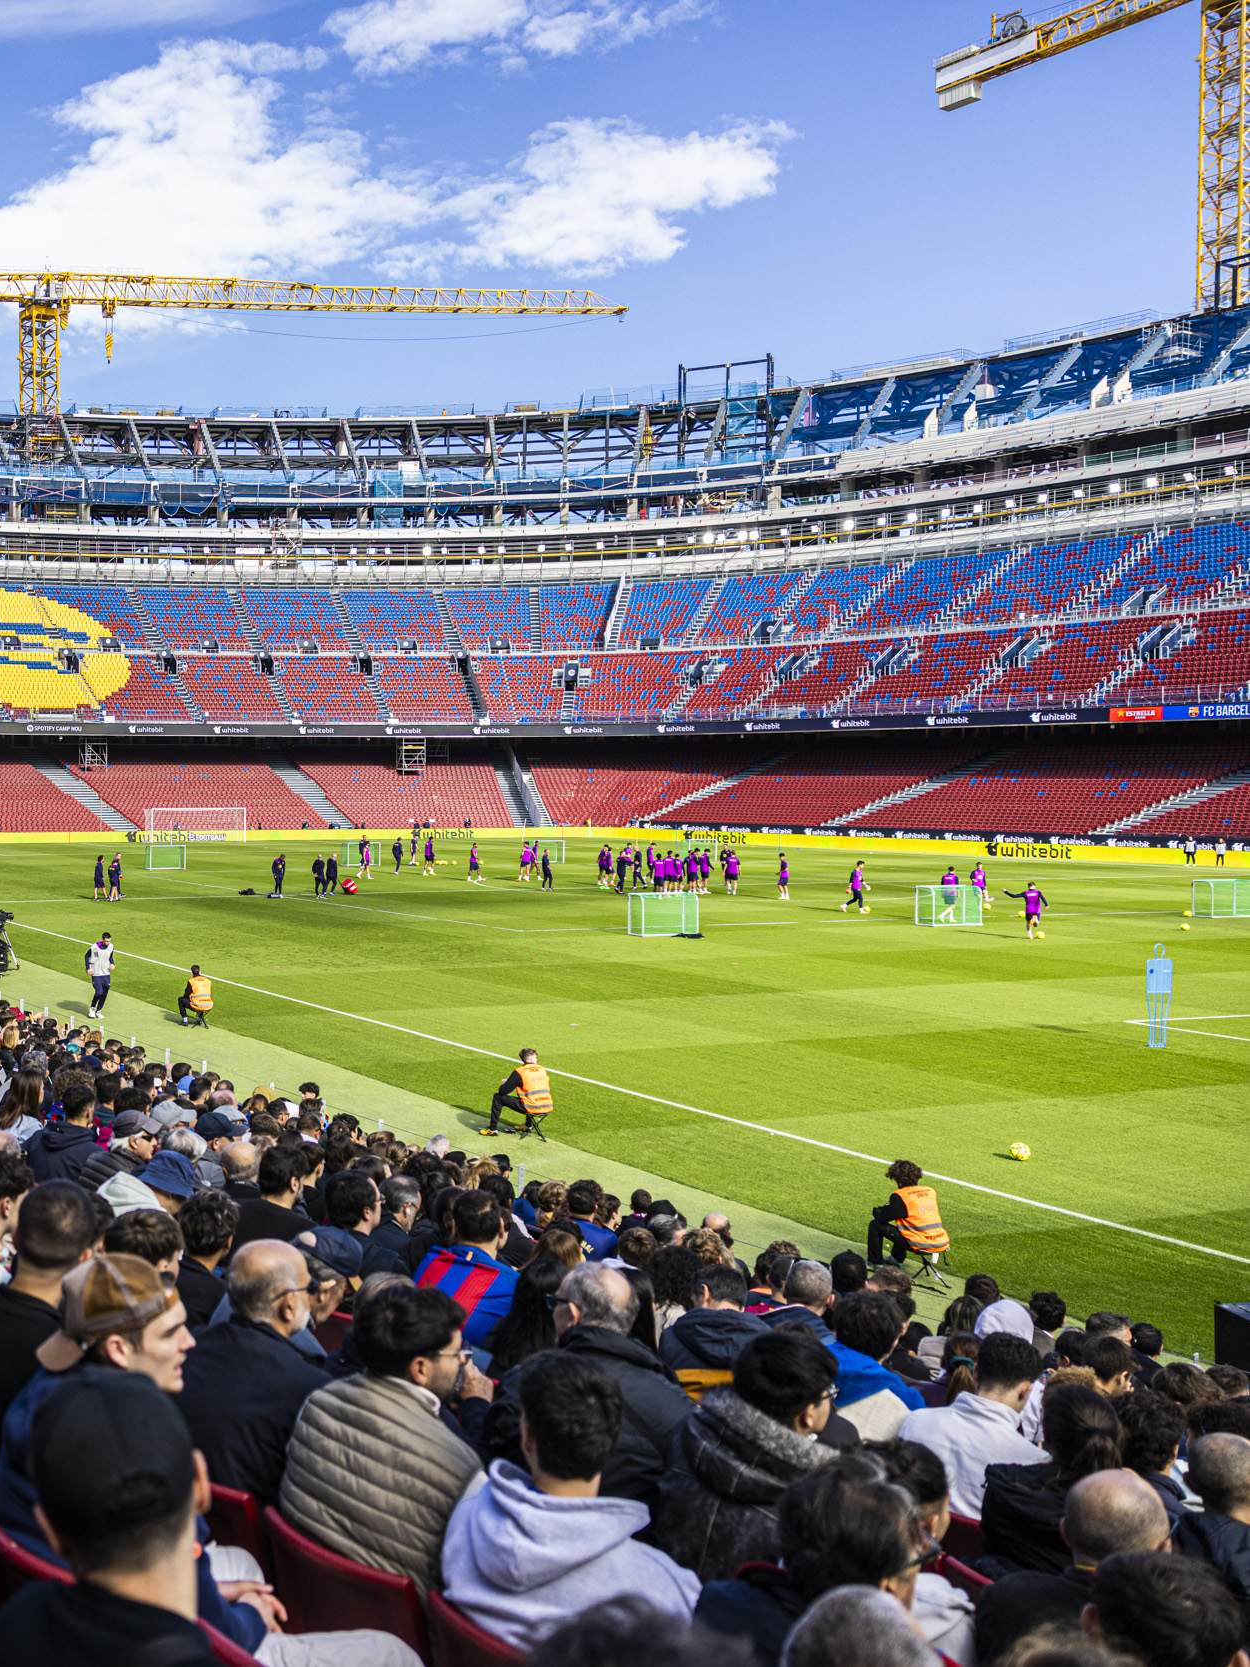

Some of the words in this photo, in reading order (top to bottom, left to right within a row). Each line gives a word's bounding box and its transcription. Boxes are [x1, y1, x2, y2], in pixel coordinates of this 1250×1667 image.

[1040, 711, 1078, 721] whitebit
[1125, 709, 1156, 717] ESTRELLA
[1203, 705, 1215, 717] FC
[840, 718, 870, 728] whitebit
[936, 715, 970, 725] whitebit
[34, 725, 55, 733] SPOTIFY
[56, 725, 70, 733] CAMP
[71, 725, 82, 733] NOU
[137, 726, 164, 734] whitebit
[221, 727, 249, 735] whitebit
[307, 727, 335, 735] whitebit
[394, 726, 422, 735] whitebit
[481, 726, 511, 735] whitebit
[572, 725, 603, 735] whitebit
[665, 725, 695, 733] whitebit
[753, 722, 781, 731] whitebit
[423, 828, 474, 840] whitebit
[694, 831, 747, 845] whitebit
[1059, 836, 1092, 846] whitebit
[1117, 837, 1150, 848] whitebit
[1001, 844, 1073, 860] whitebit
